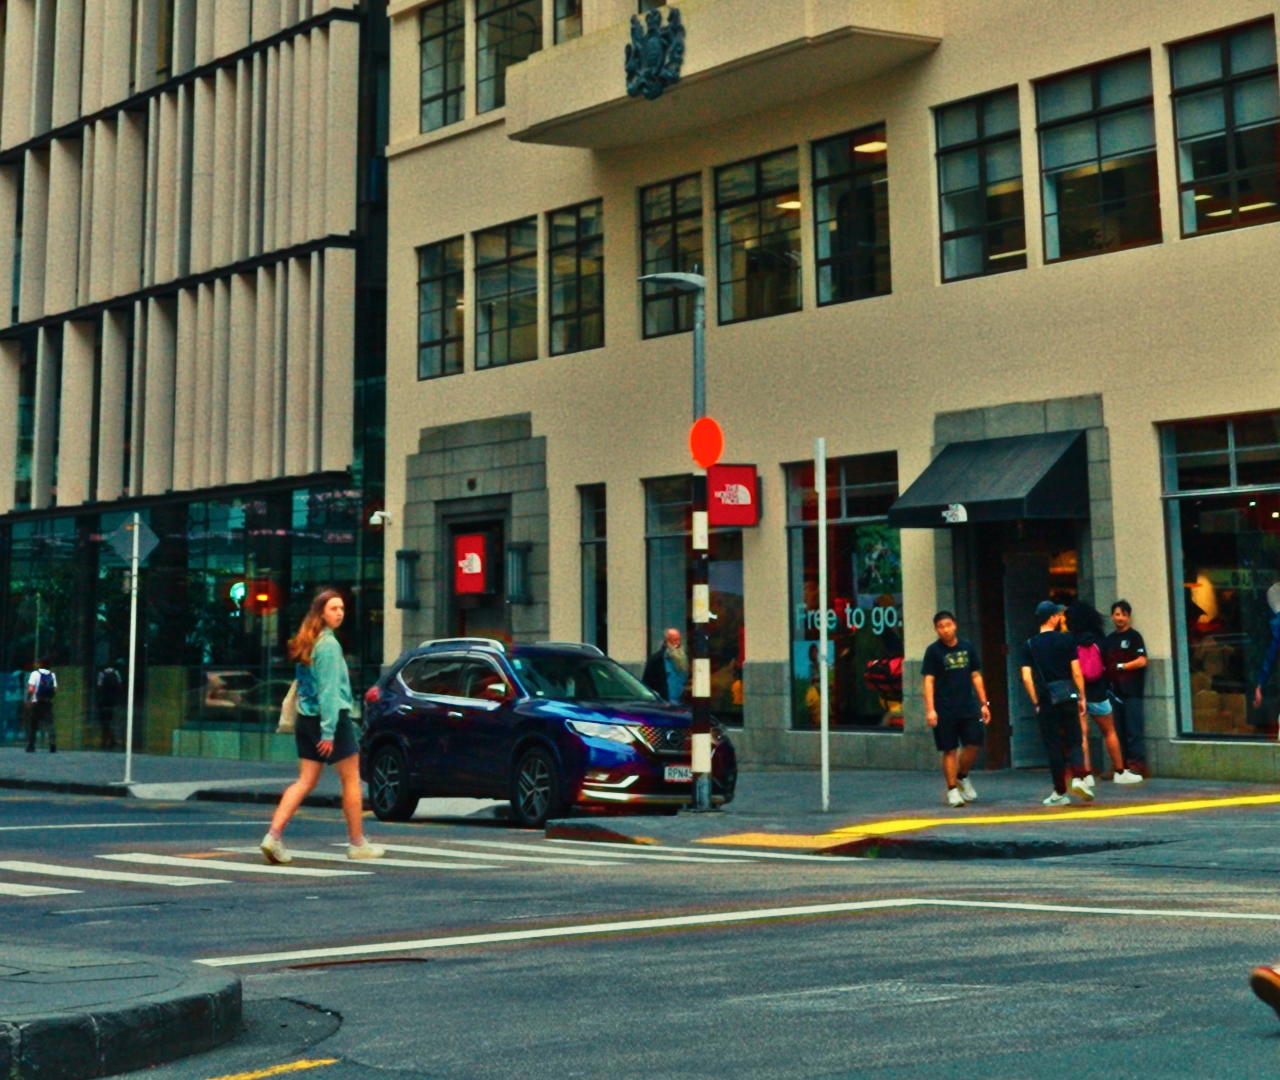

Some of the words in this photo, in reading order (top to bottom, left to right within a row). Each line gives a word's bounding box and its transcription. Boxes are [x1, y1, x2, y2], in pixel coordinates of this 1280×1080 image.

[797, 603, 838, 630] Free
[845, 603, 865, 629] to
[871, 606, 902, 635] go.
